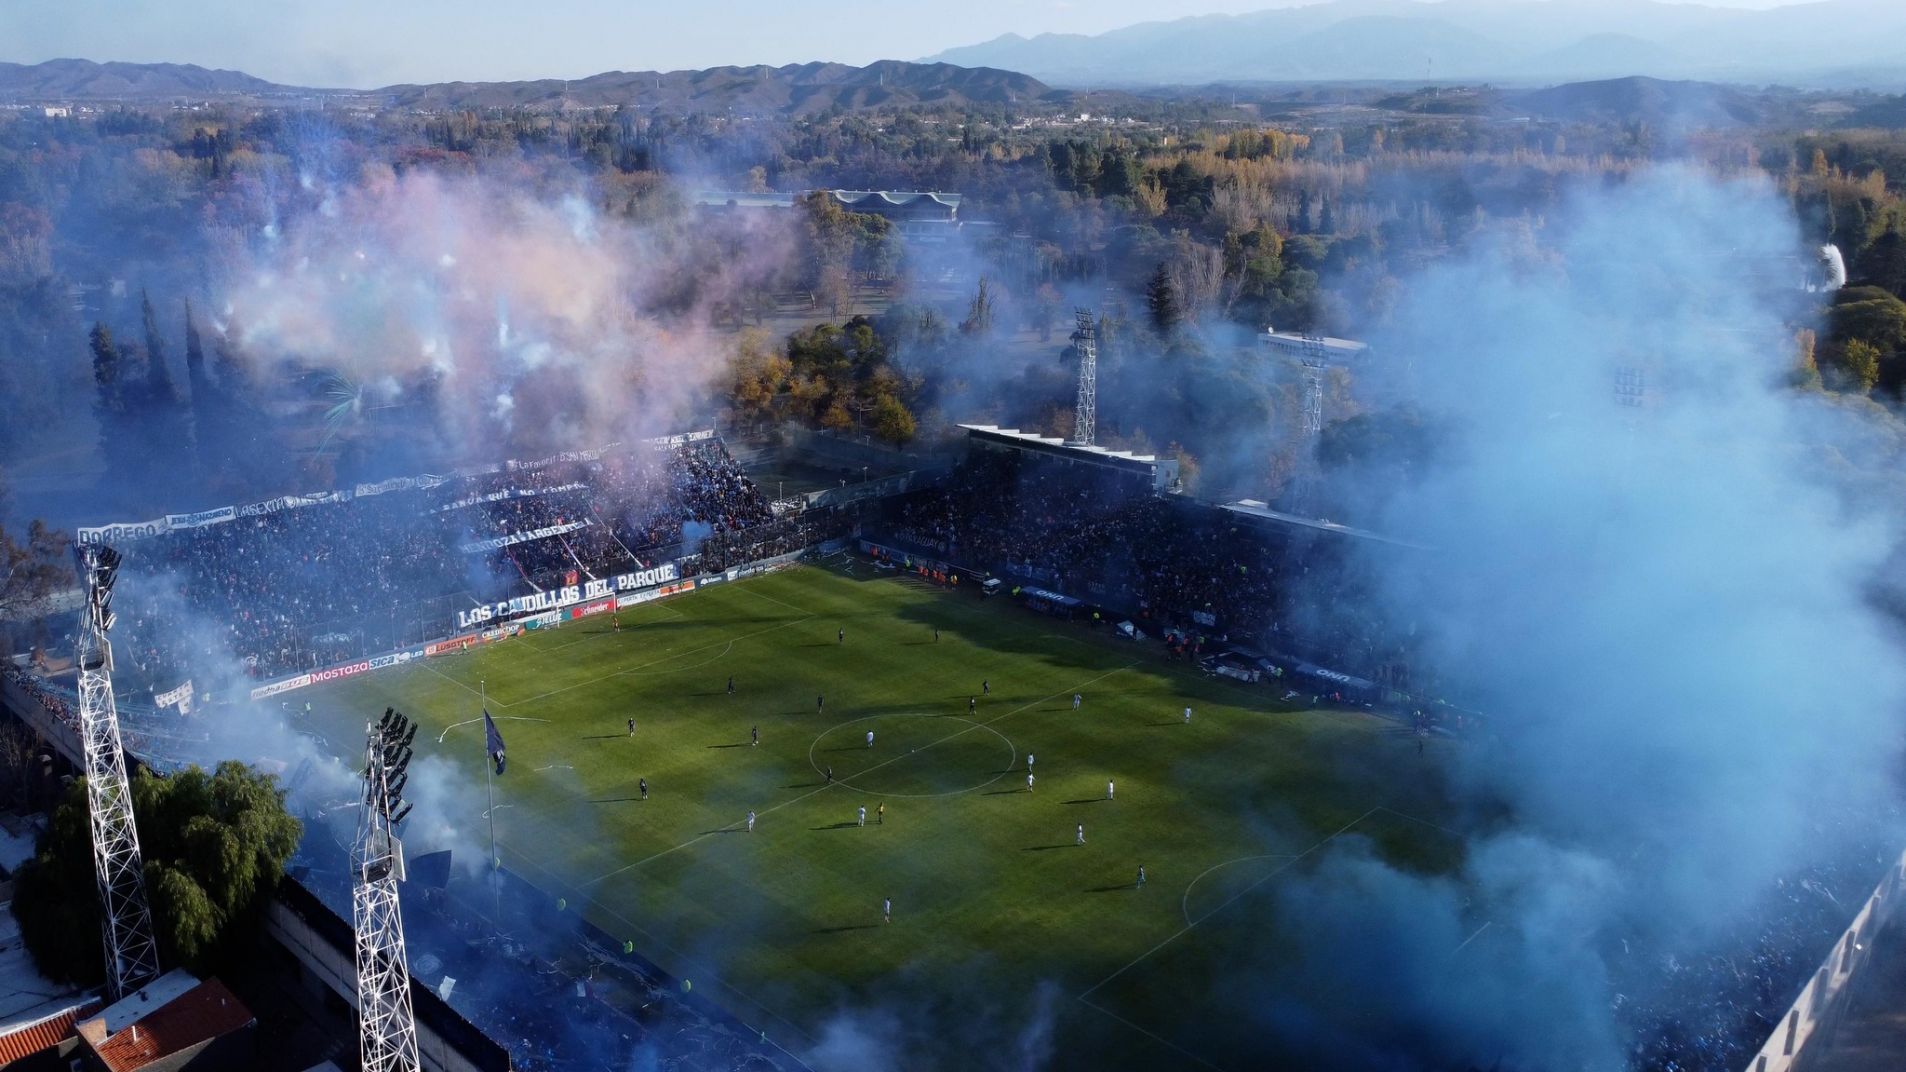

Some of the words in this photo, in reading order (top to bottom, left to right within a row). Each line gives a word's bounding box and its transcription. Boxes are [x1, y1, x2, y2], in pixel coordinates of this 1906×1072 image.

[79, 523, 156, 546] DORREGO
[526, 517, 594, 541] ARGENTA
[459, 606, 491, 628] LOS
[585, 579, 613, 599] DEL
[617, 564, 674, 590] PARQUE
